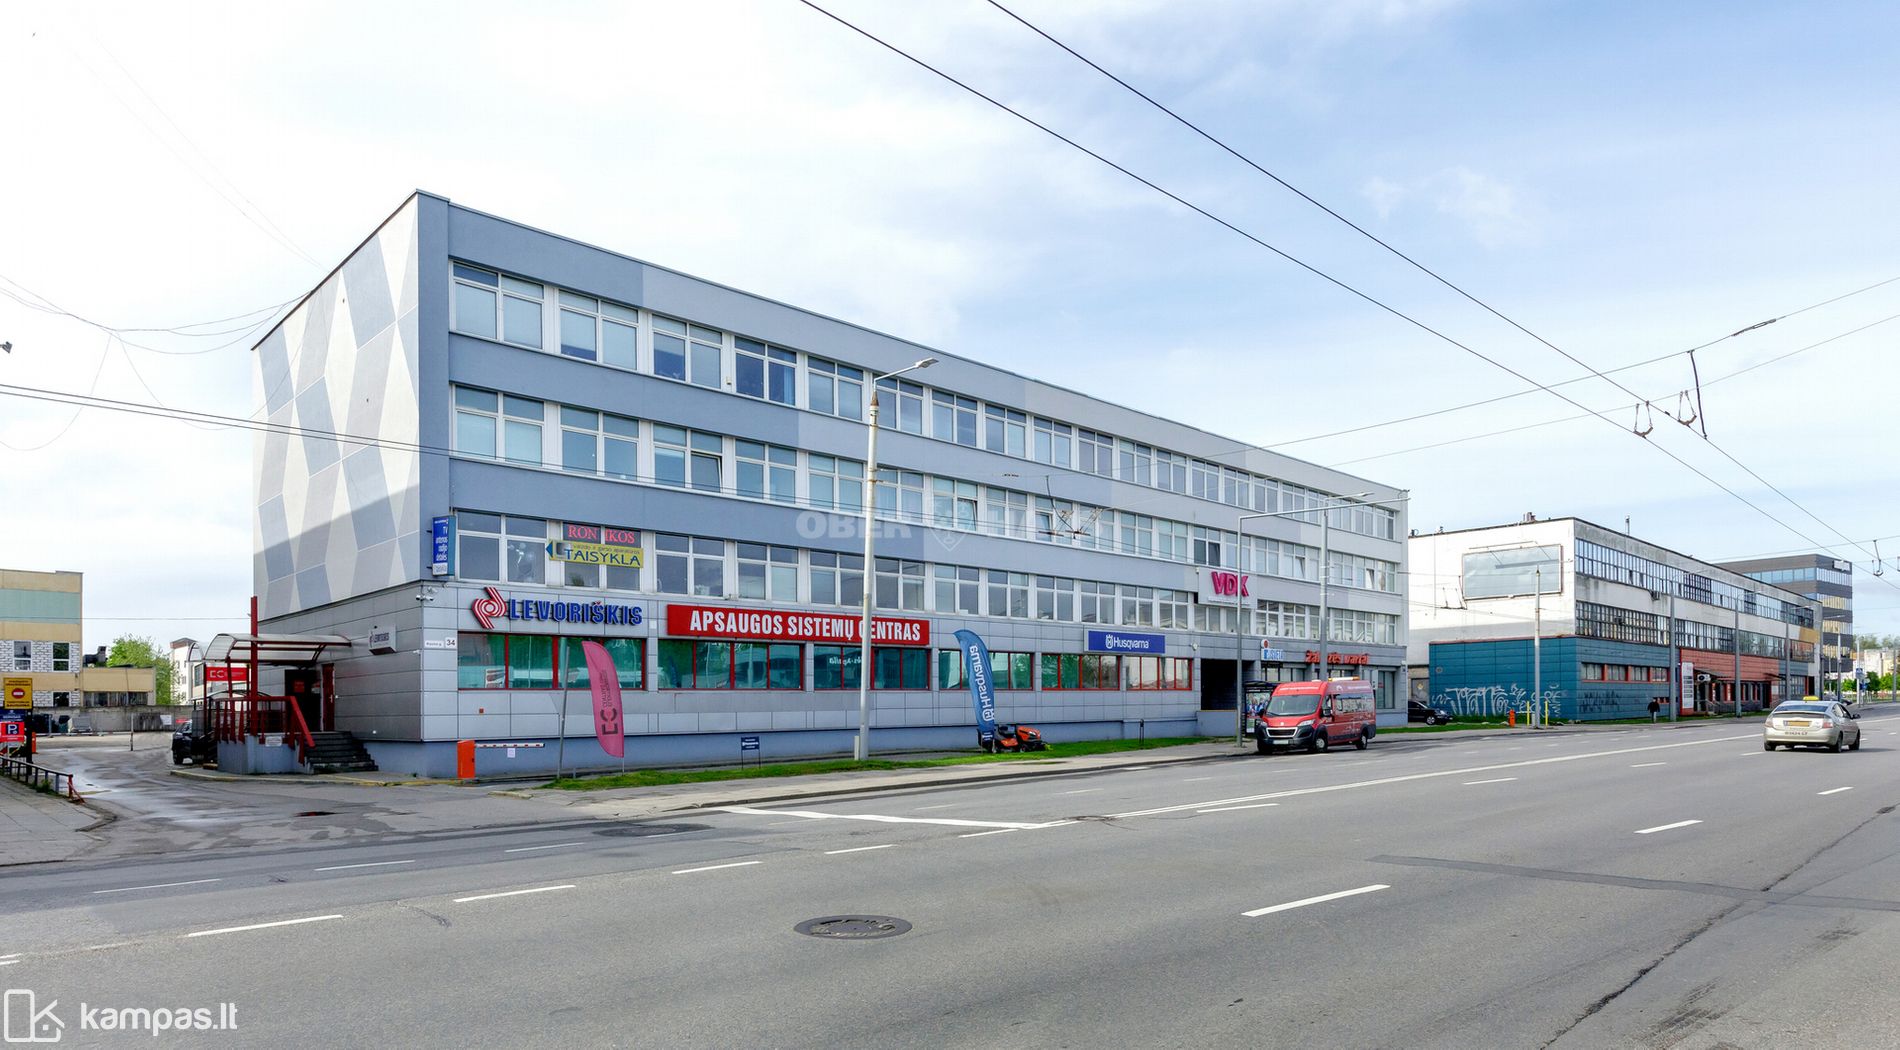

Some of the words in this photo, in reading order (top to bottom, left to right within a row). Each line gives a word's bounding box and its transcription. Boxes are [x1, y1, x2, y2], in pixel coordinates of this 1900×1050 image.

[564, 548, 641, 566] TAISYKLA
[1211, 571, 1249, 597] VDK
[509, 599, 643, 626] LEVORIŠKIS
[690, 610, 783, 635] APSAUGOS
[788, 616, 853, 640] SISTEMŲ
[1113, 636, 1149, 650] Husqvarna
